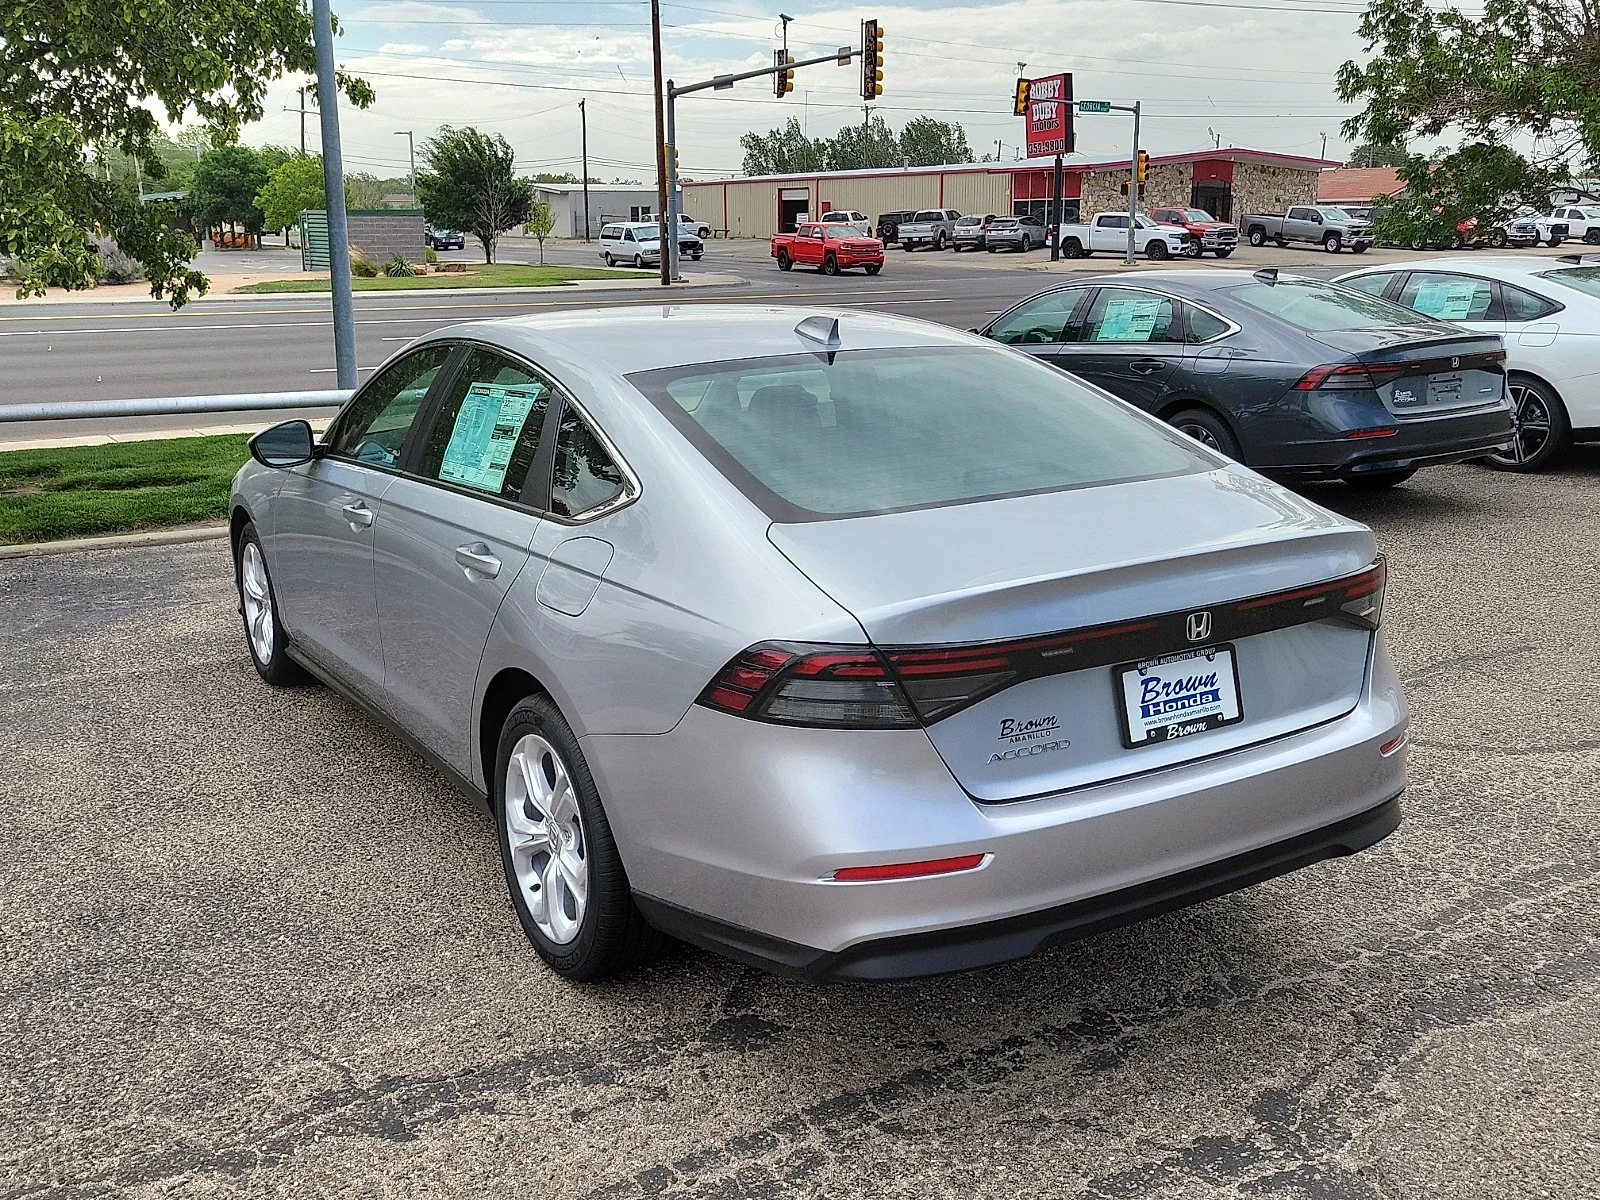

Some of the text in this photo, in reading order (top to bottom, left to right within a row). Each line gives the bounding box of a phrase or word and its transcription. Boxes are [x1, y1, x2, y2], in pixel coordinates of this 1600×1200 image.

[1032, 102, 1058, 121] DUBY
[1080, 102, 1101, 111] GEORGIA
[1032, 119, 1060, 132] motors
[1028, 138, 1065, 155] 352-9800
[1137, 647, 1216, 669] BROWN AUTOMOTIVE GROUP
[1140, 672, 1218, 704] Brown
[1149, 693, 1213, 715] Honda
[1000, 715, 1059, 736] Brown
[1167, 721, 1208, 739] Brown
[1009, 731, 1051, 744] AMARILLO
[986, 739, 1071, 765] ACCORD
